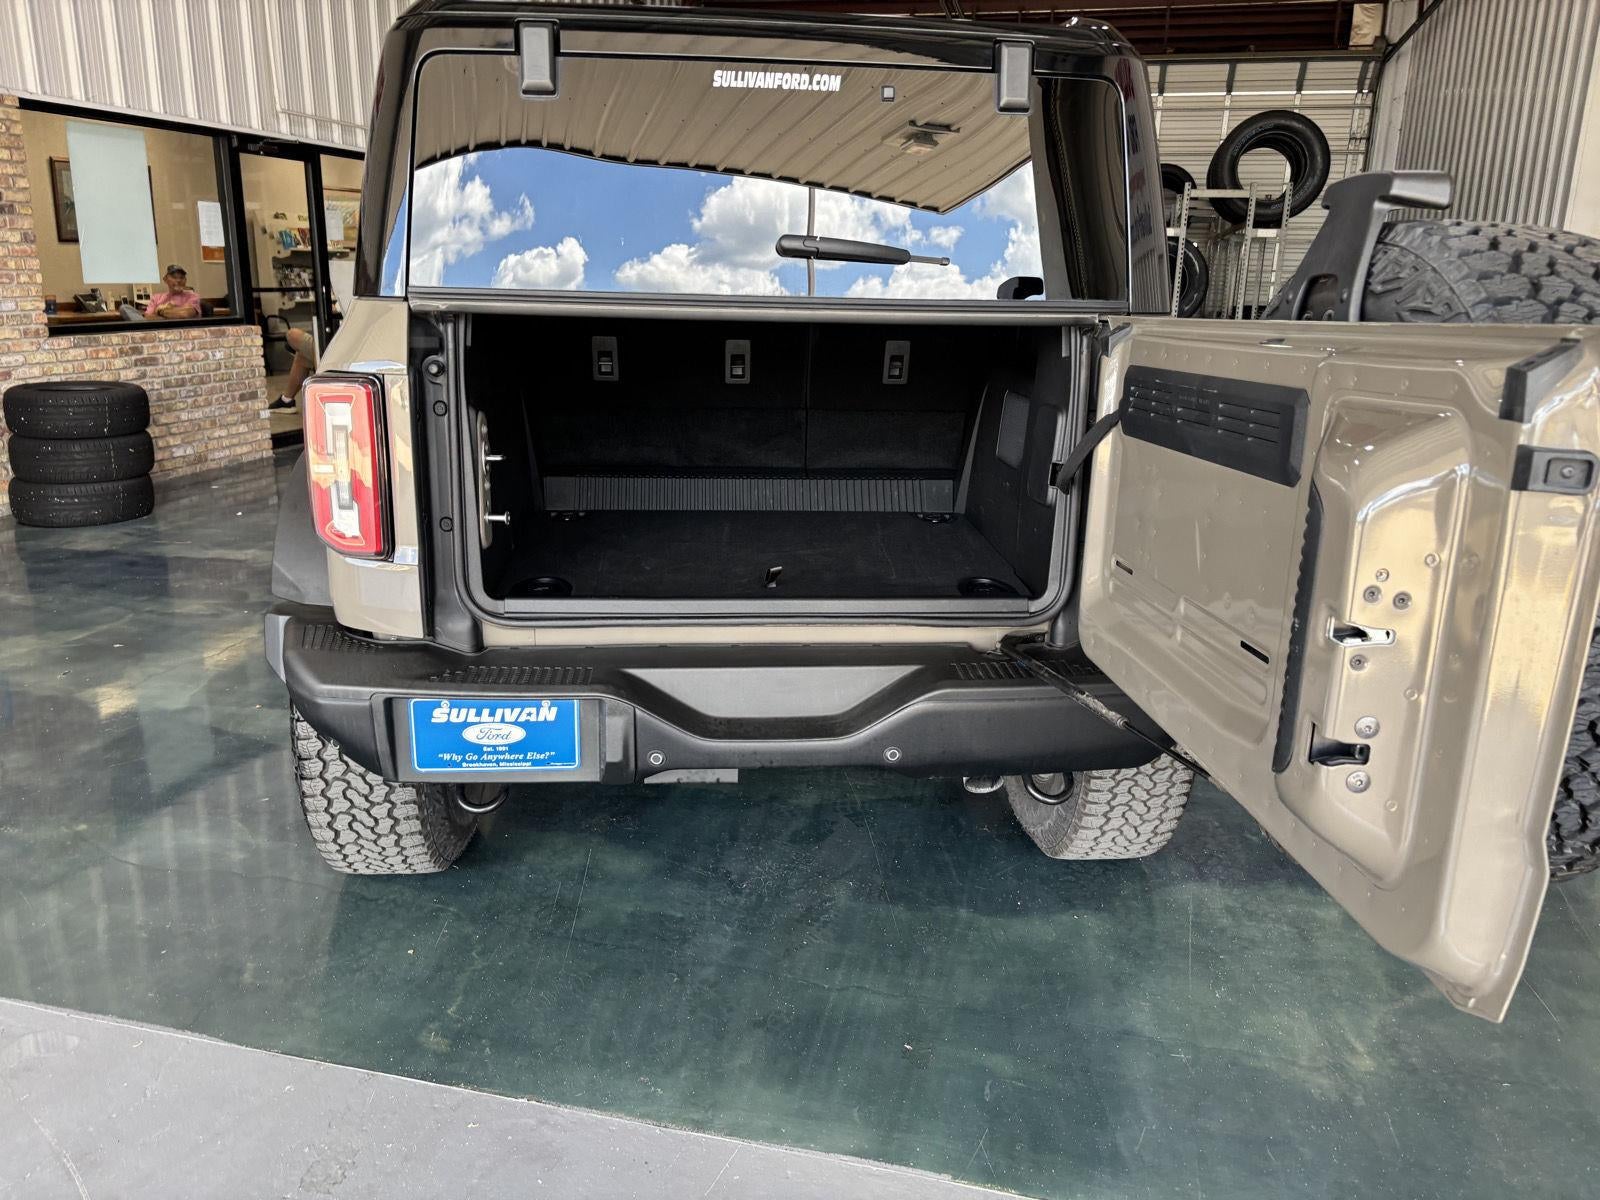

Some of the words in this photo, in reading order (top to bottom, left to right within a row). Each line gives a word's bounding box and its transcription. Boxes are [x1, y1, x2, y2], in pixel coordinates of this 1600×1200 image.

[713, 70, 842, 92] SULLIVANFORD.COM
[431, 706, 558, 723] SULLIVAN
[475, 727, 512, 741] Ford
[465, 752, 478, 761] Go
[480, 752, 524, 762] Anywhere
